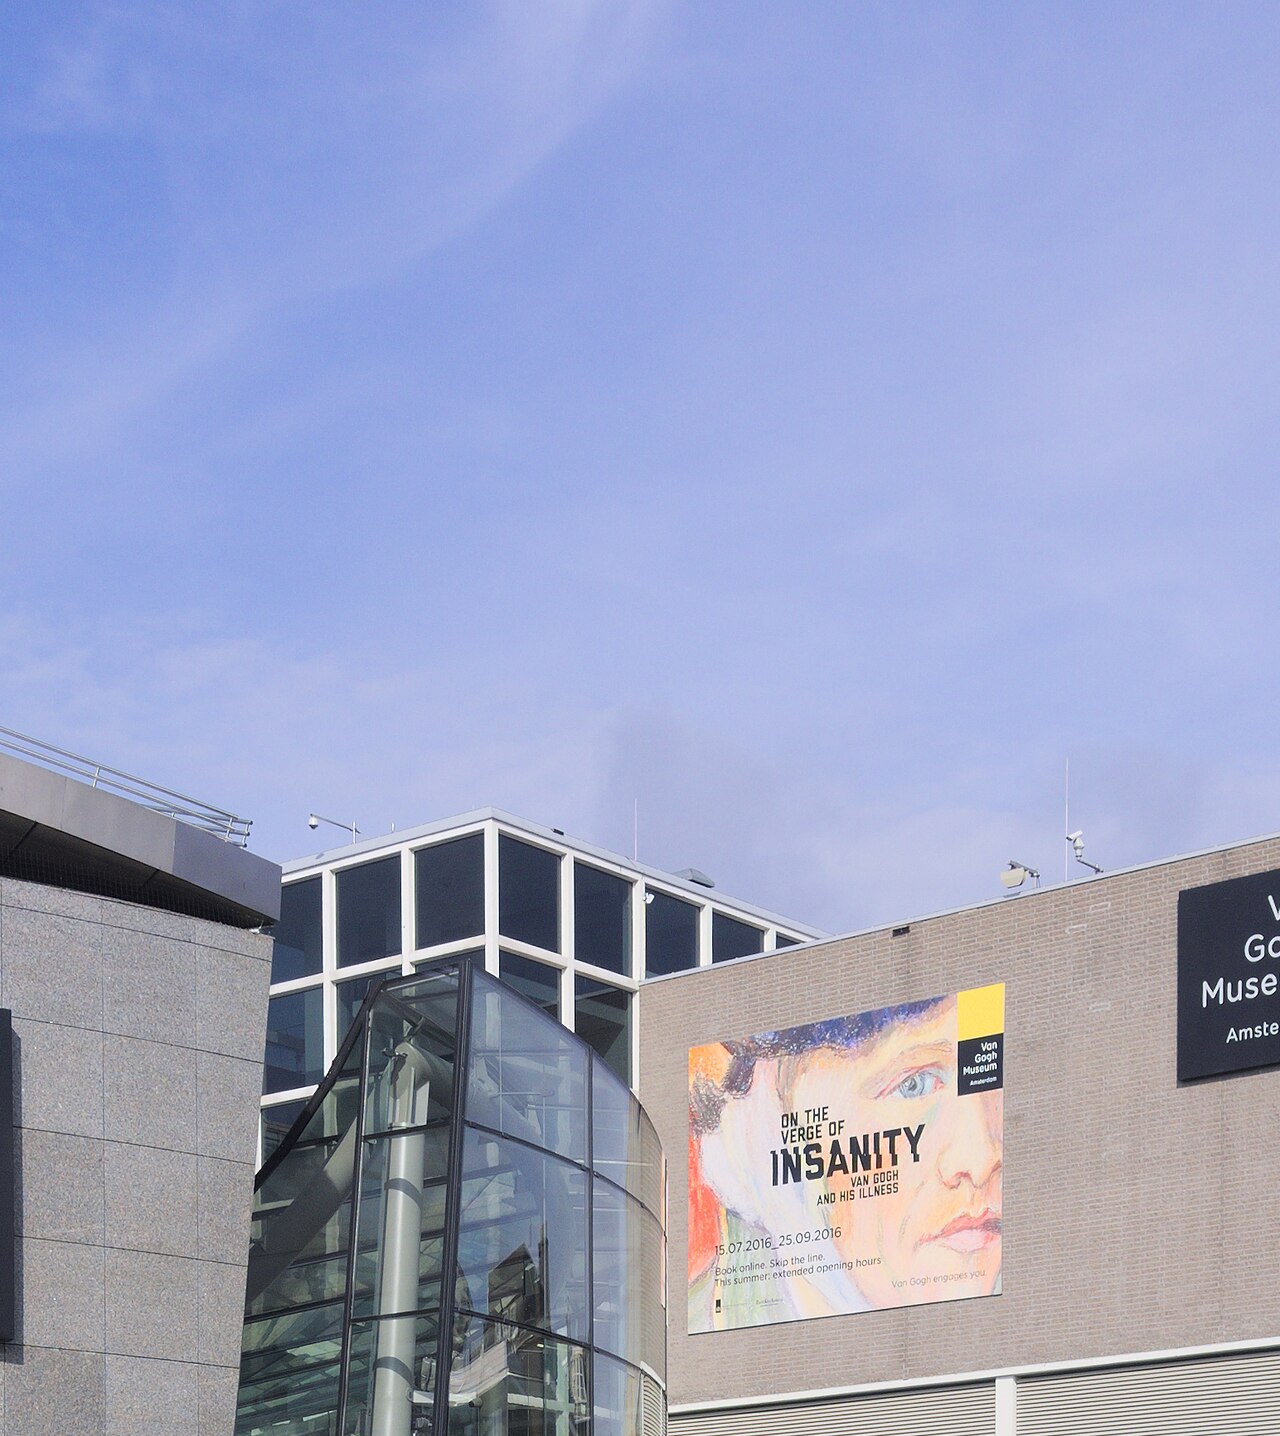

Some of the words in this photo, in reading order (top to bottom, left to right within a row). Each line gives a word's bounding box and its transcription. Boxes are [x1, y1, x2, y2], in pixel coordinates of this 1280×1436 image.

[974, 1051, 998, 1063] Gogh
[981, 1041, 998, 1052] Van
[963, 1062, 998, 1075] Museum
[781, 1112, 798, 1128] ON
[804, 1106, 829, 1123] THE
[781, 1124, 822, 1144] VERGE
[828, 1120, 845, 1137] OF
[770, 1123, 926, 1186] INSANITY
[850, 1174, 869, 1188] VAN
[873, 1170, 899, 1184] GOGH
[817, 1192, 836, 1206] AND
[839, 1189, 855, 1202] HIS
[859, 1182, 899, 1199] ILLNESS
[715, 1266, 739, 1276] Book
[740, 1262, 767, 1273] online.
[770, 1258, 789, 1269] Skip
[791, 1256, 805, 1265] the
[807, 1253, 826, 1263] line.
[715, 1278, 732, 1287] This
[772, 1265, 814, 1279] extended
[816, 1261, 853, 1274] opening
[855, 1257, 882, 1267] hours
[891, 1280, 908, 1288] Van
[909, 1276, 931, 1287] Gogh
[933, 1271, 968, 1283] engages
